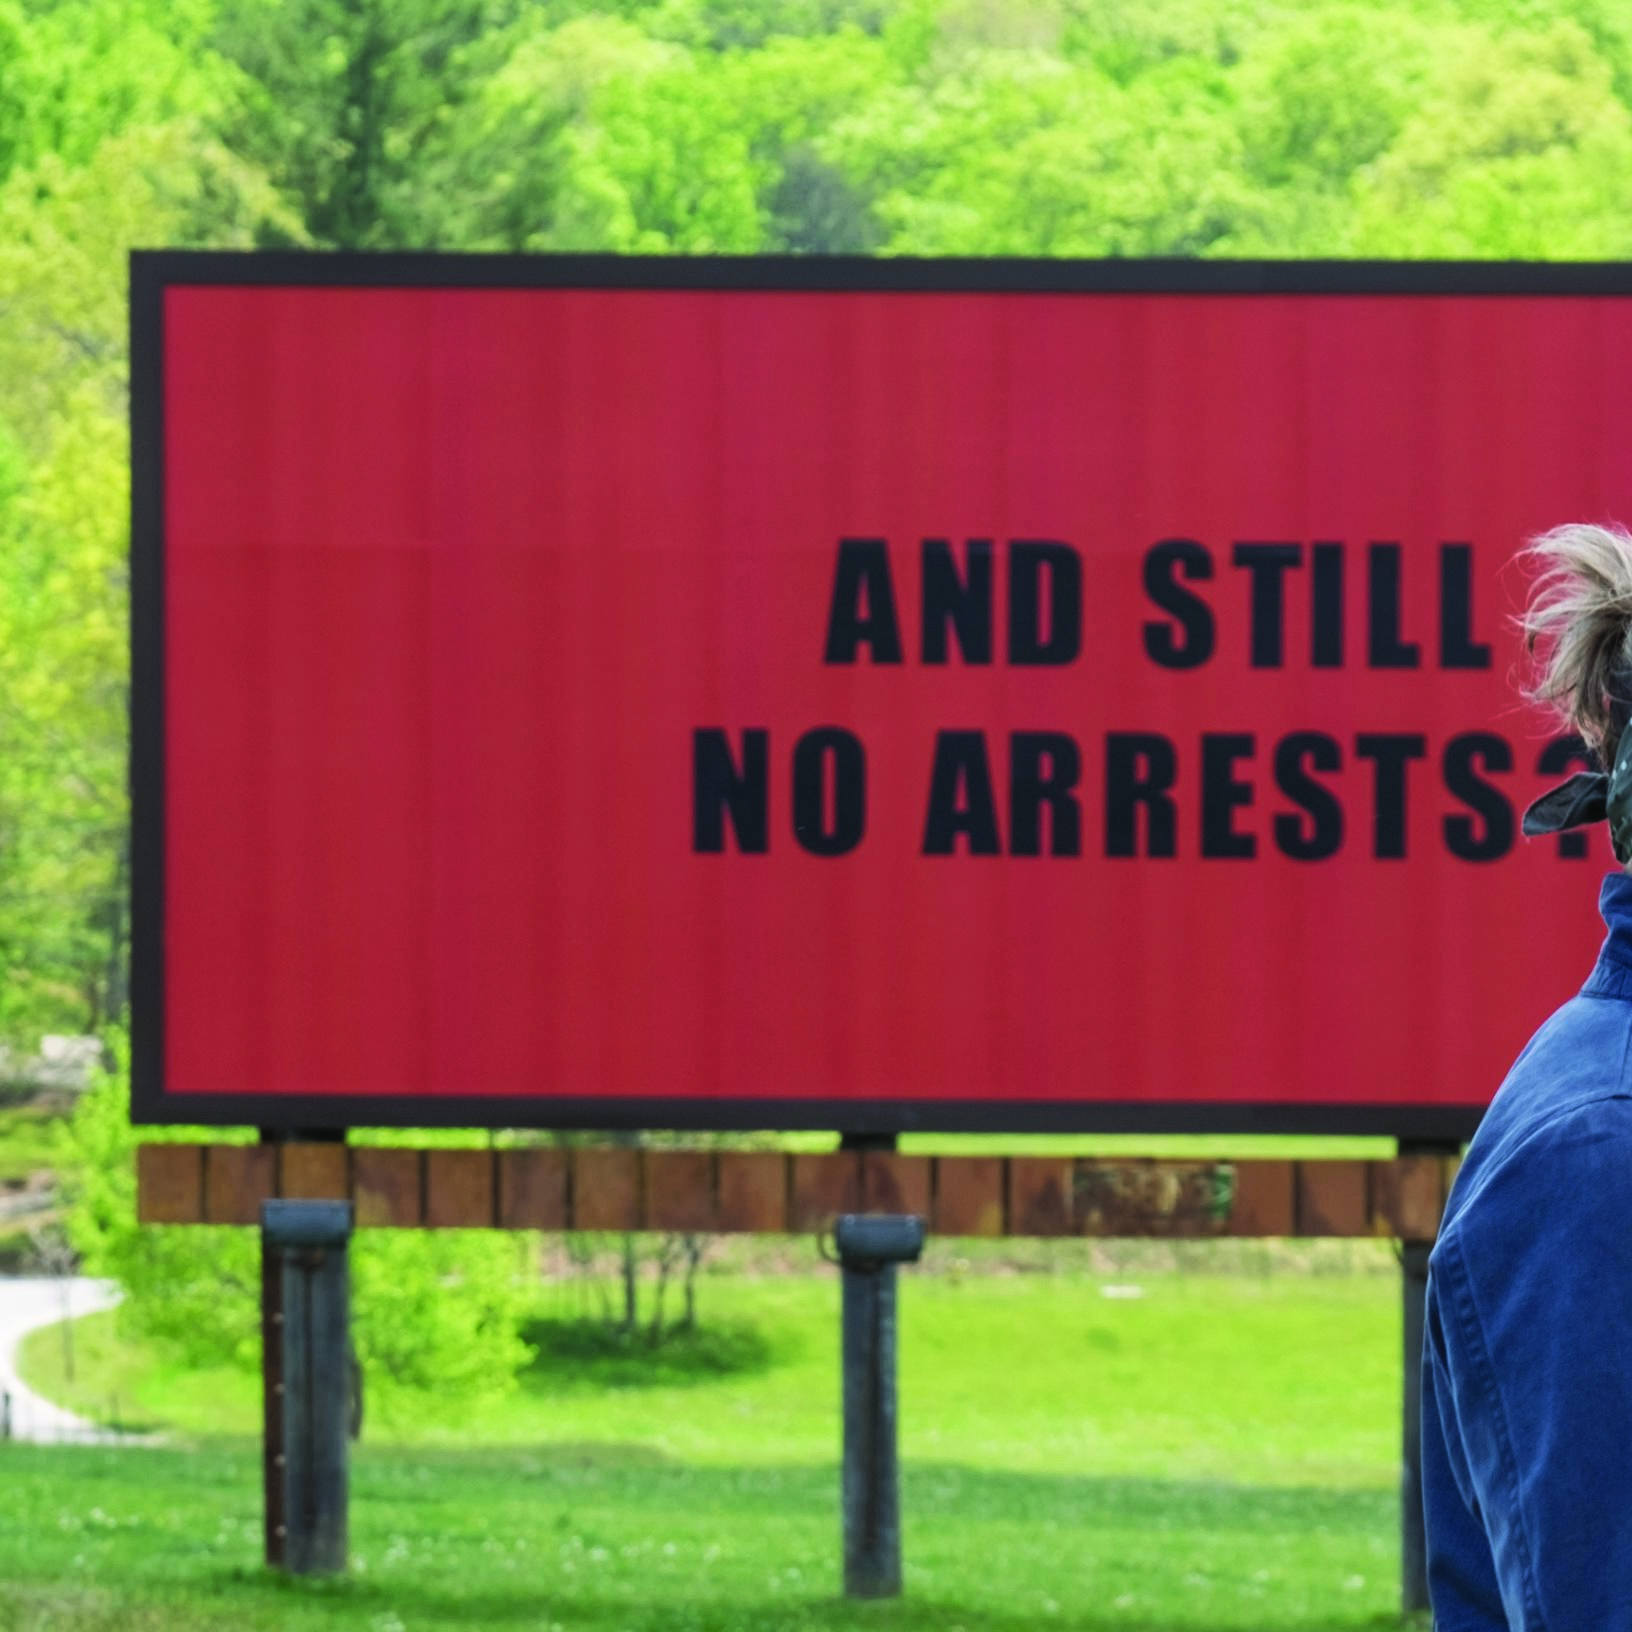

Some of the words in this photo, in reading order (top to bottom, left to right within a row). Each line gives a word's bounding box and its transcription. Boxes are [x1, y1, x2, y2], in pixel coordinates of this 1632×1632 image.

[822, 537, 1084, 668] AND
[1141, 538, 1493, 671] STILL
[691, 724, 868, 860] NO
